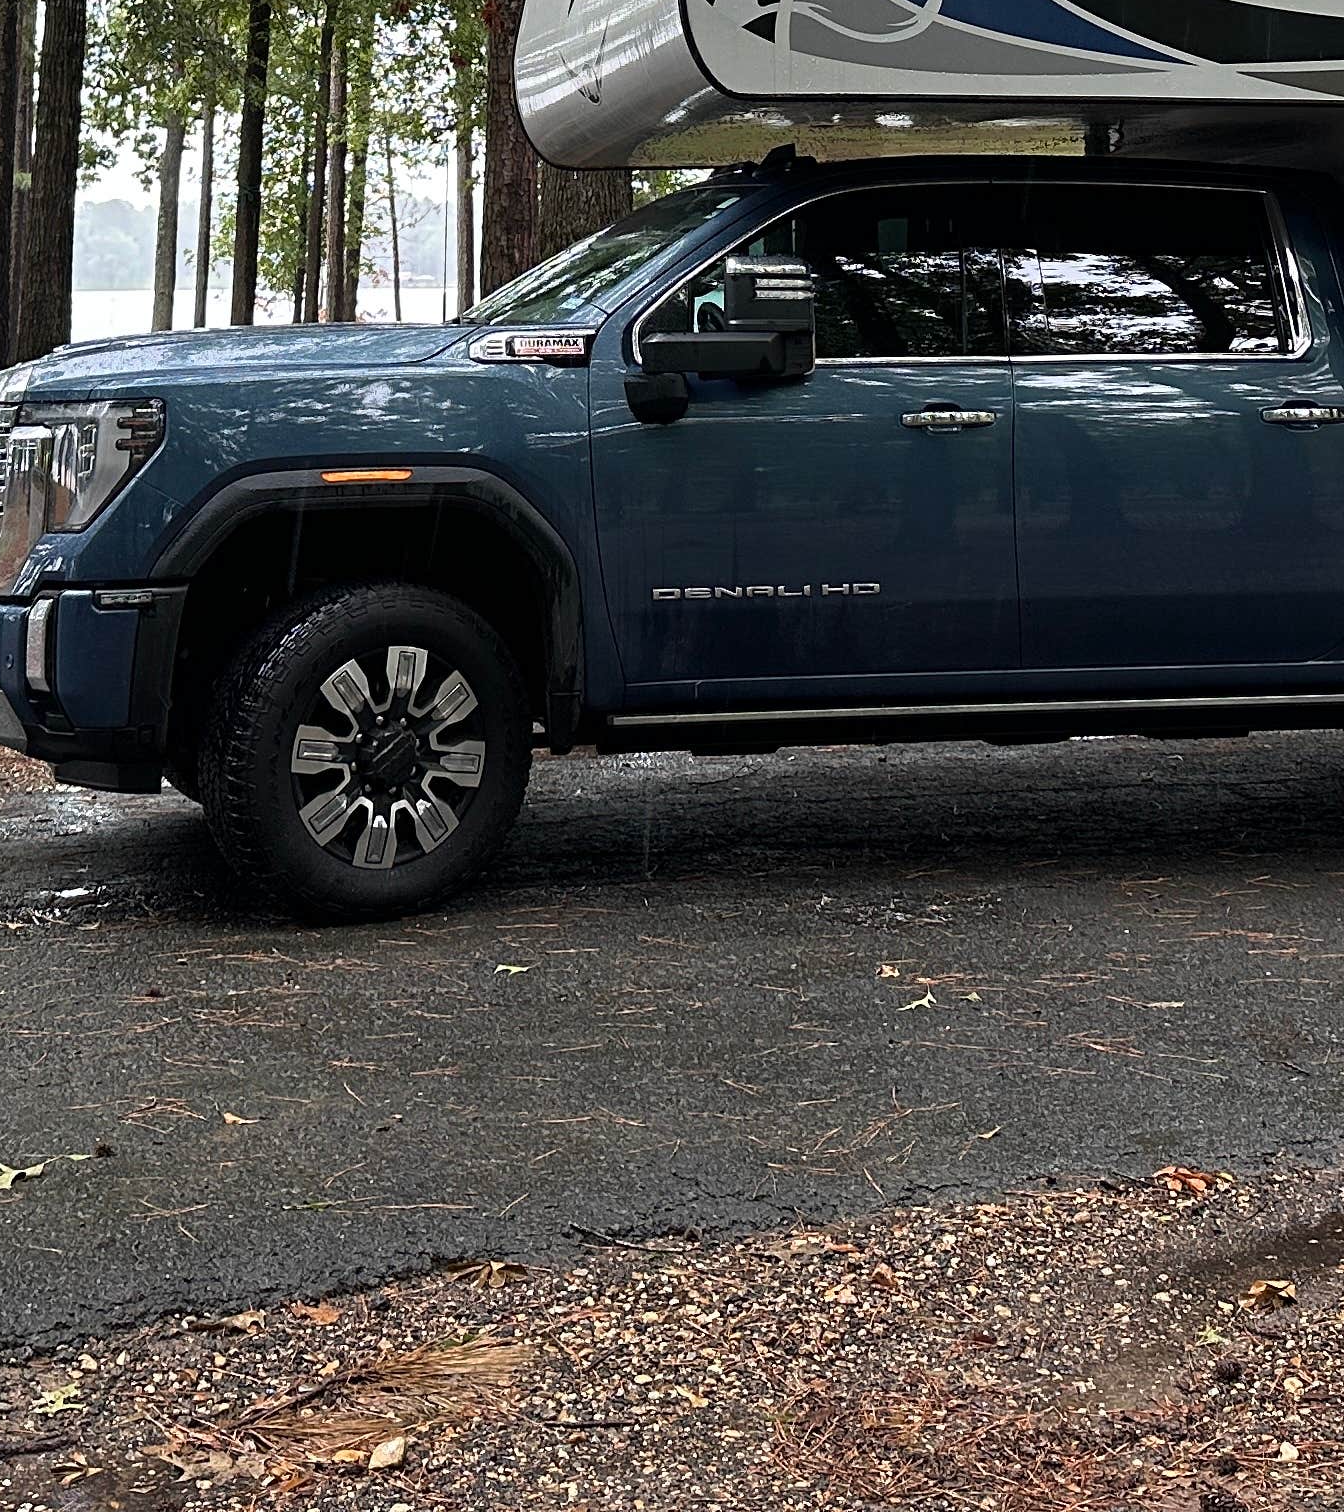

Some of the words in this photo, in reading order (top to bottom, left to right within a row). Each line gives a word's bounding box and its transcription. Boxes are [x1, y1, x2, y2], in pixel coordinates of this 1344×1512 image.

[519, 338, 580, 348] DURAMAX
[651, 584, 812, 601] DENALI
[821, 582, 881, 596] HD
